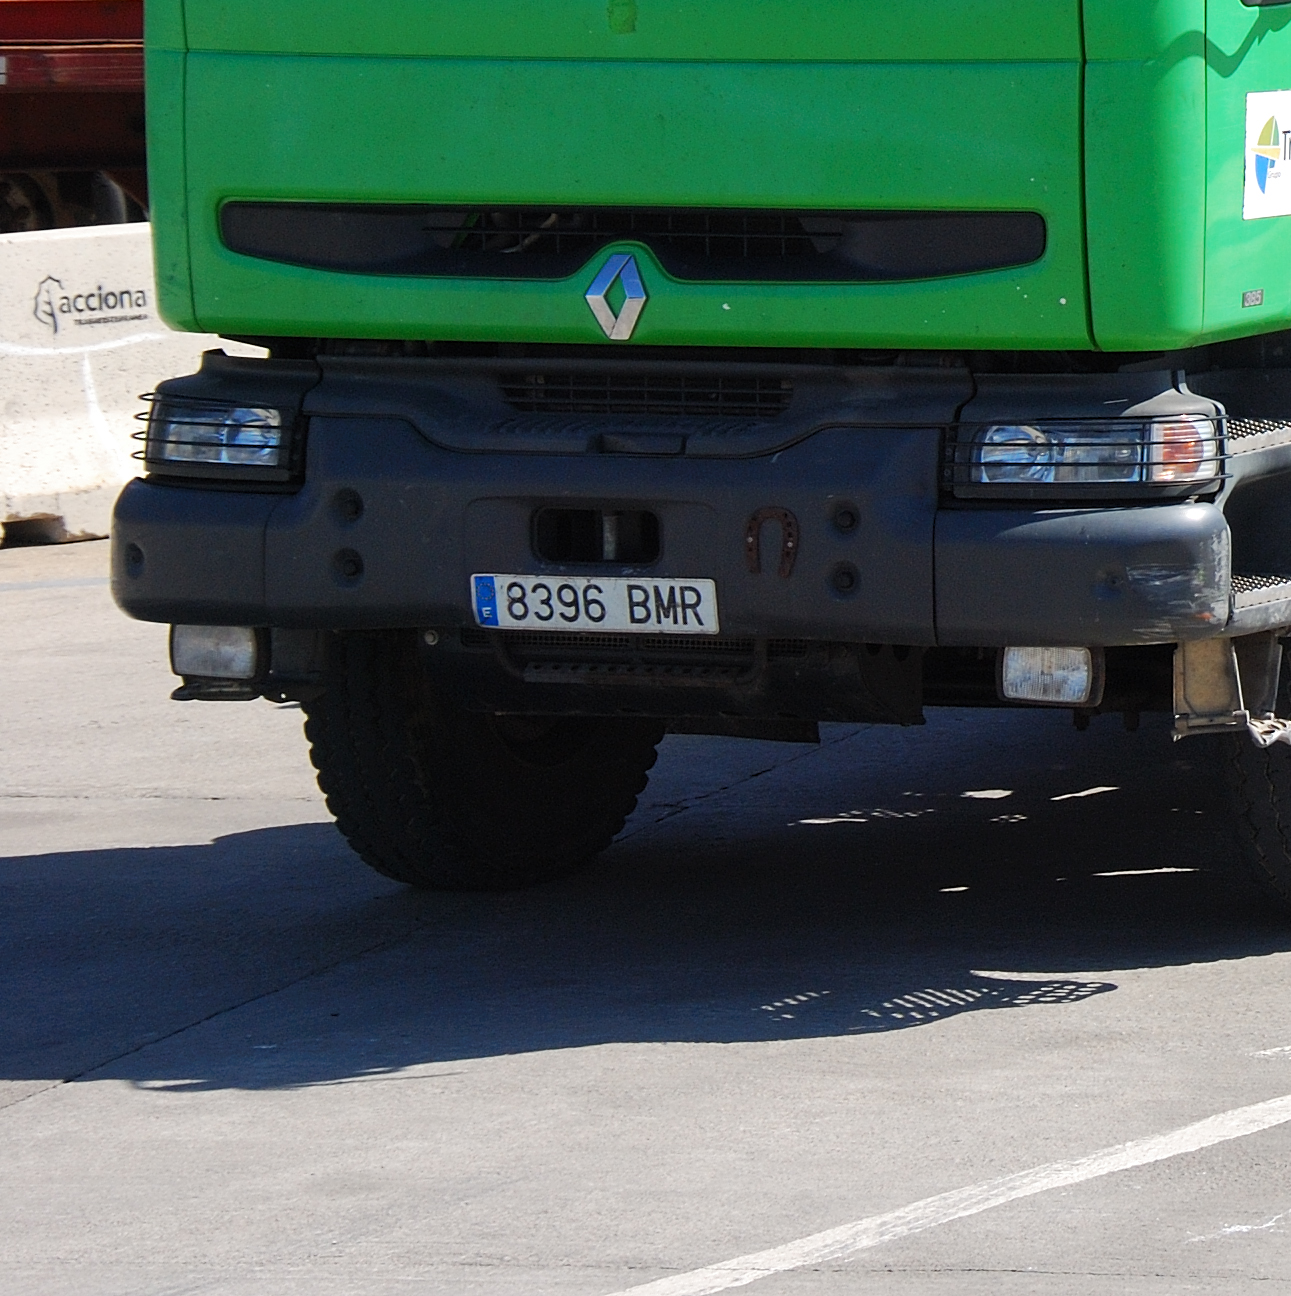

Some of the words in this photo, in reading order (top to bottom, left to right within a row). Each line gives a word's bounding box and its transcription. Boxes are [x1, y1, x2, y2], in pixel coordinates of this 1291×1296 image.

[59, 285, 147, 314] acciona
[482, 607, 493, 619] E
[506, 581, 607, 624] 8396
[626, 583, 705, 627] BMR
